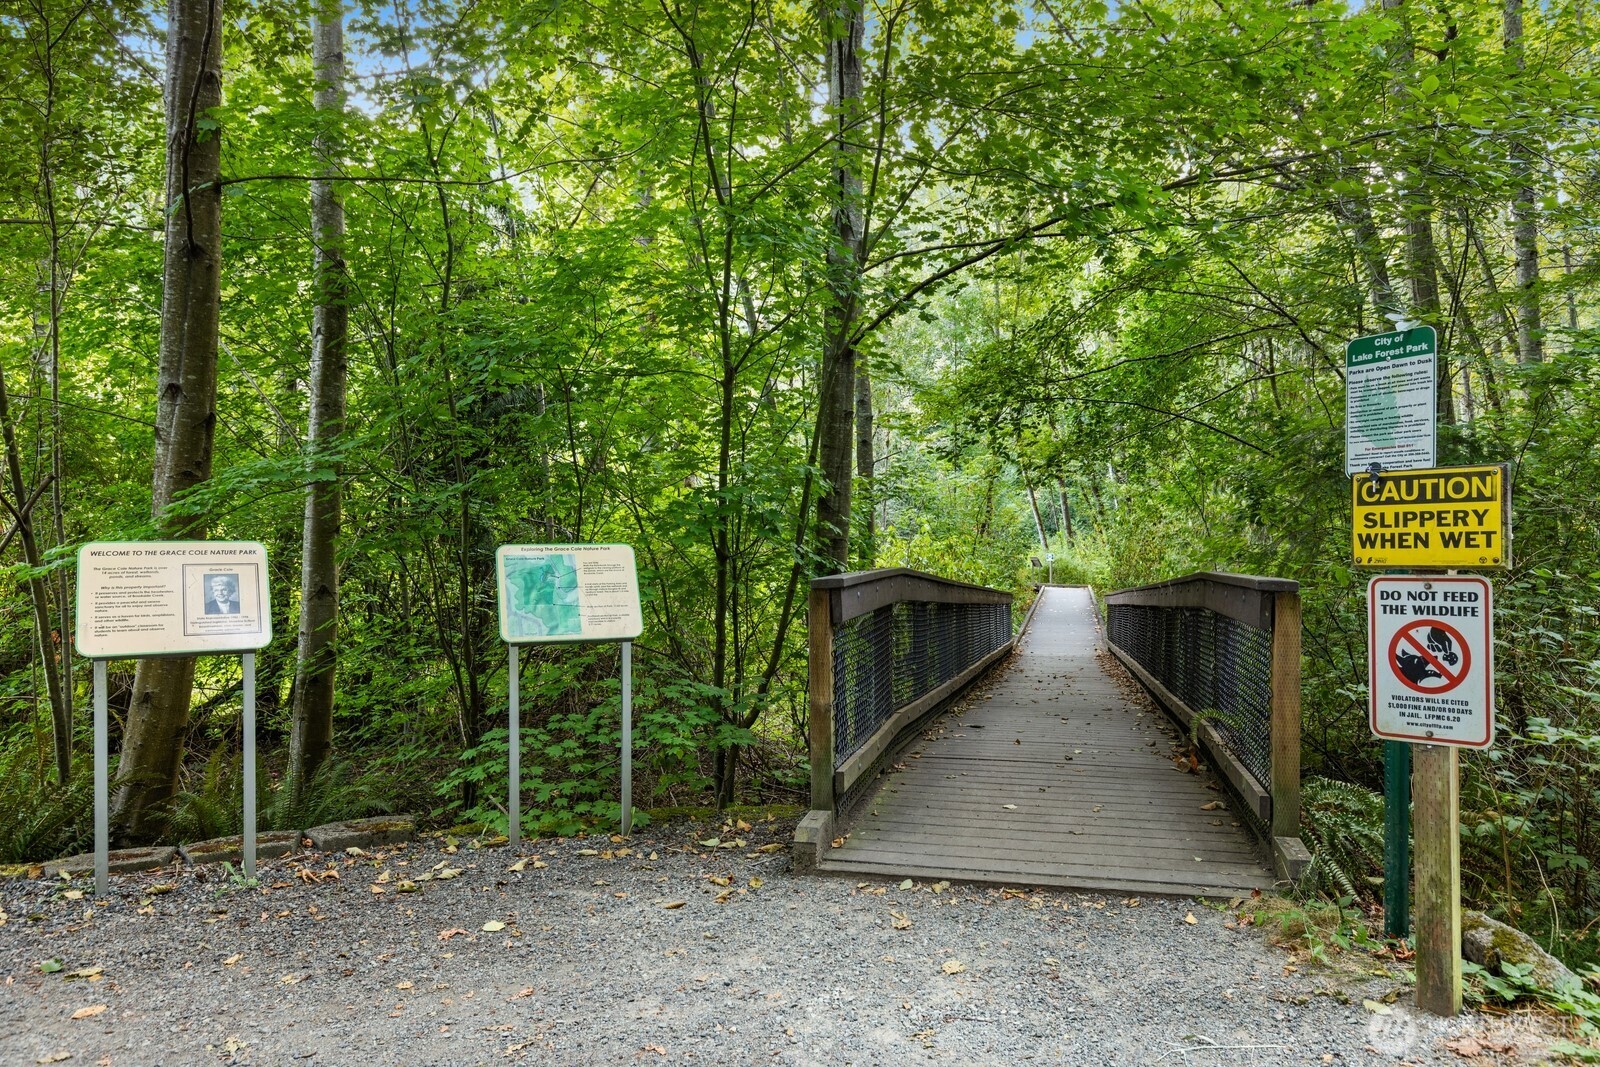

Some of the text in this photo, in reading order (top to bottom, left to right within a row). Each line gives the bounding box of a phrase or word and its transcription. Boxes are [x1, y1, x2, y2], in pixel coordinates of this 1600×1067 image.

[1374, 337, 1392, 346] City
[1352, 343, 1428, 362] Lake Forest Park
[1361, 476, 1492, 502] CAUTION
[1363, 509, 1490, 529] SLIPPERY
[1357, 531, 1497, 550] WHEN WET
[1380, 590, 1479, 602] DO NOT FEED
[1380, 604, 1479, 617] THE WILDLIFE
